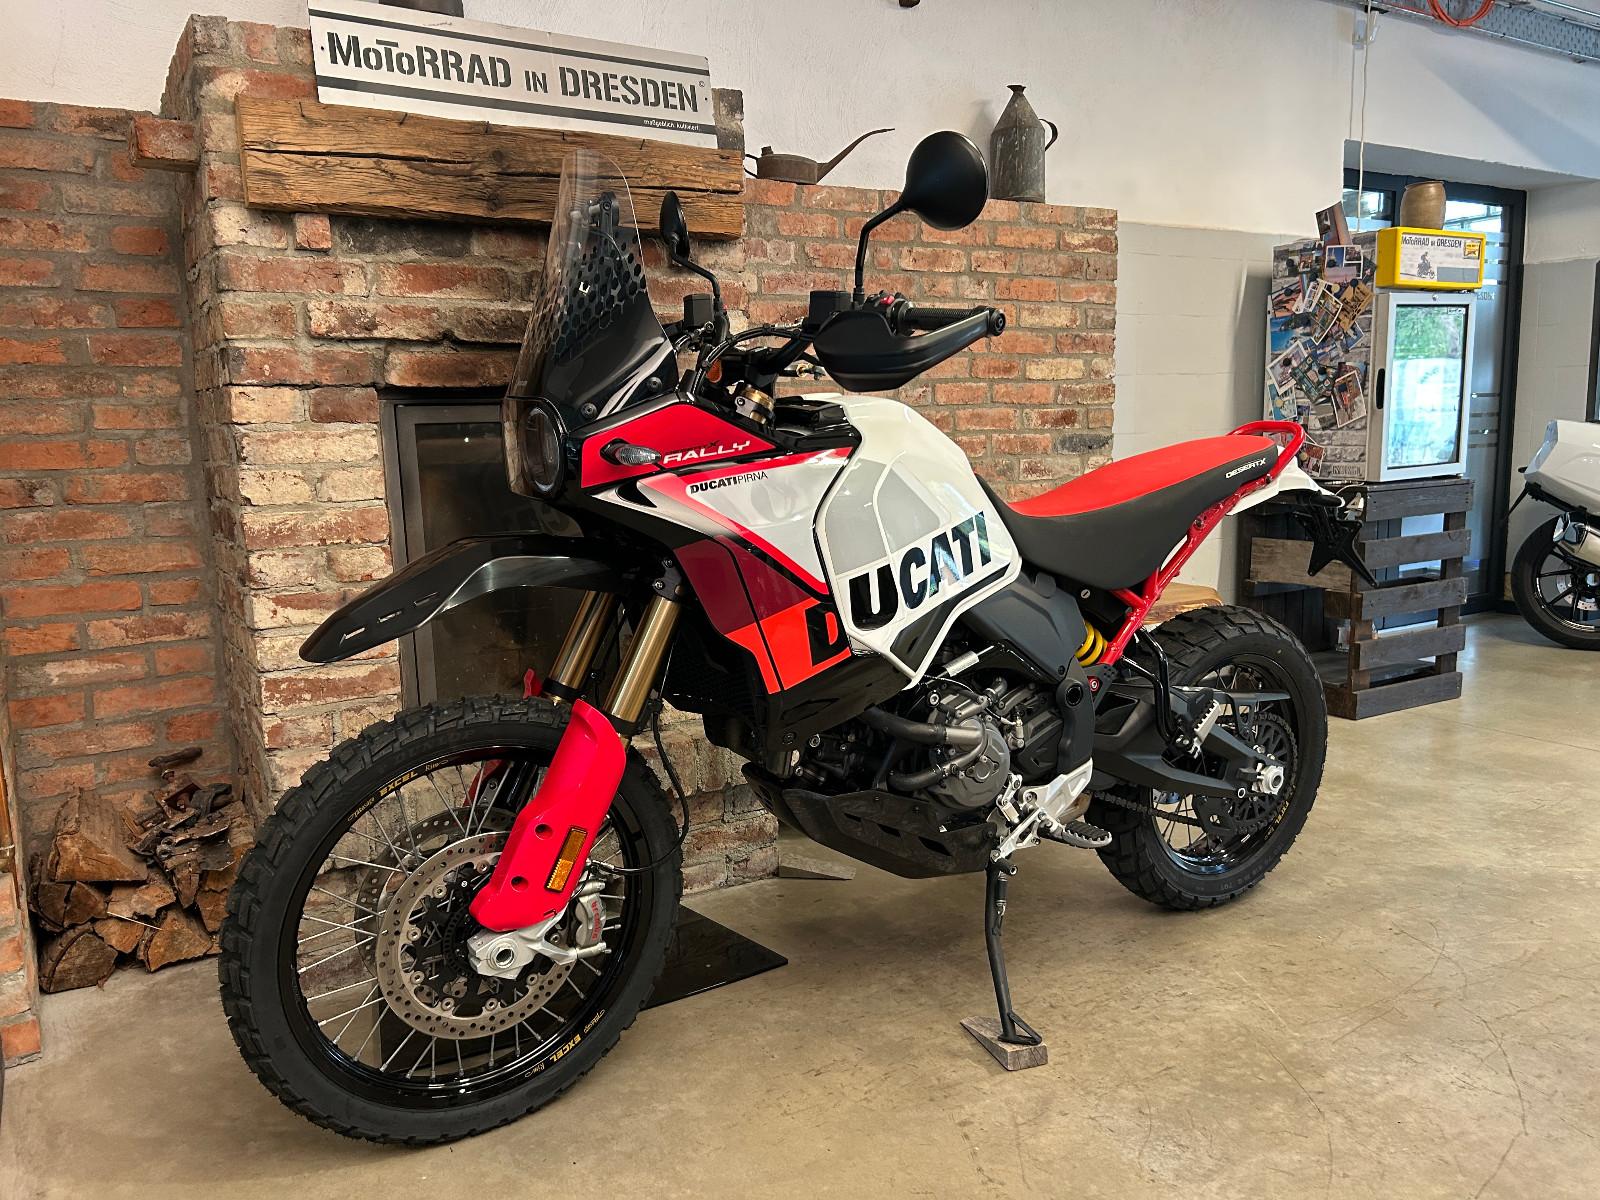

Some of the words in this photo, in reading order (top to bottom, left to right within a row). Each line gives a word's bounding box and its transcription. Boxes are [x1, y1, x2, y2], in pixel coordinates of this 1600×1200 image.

[524, 70, 549, 94] IN
[558, 66, 698, 113] DRESDEN
[1436, 238, 1462, 248] DRESDEN
[662, 440, 751, 464] RALLY
[380, 771, 418, 797] EXCEL
[549, 1033, 582, 1062] EXCEL
